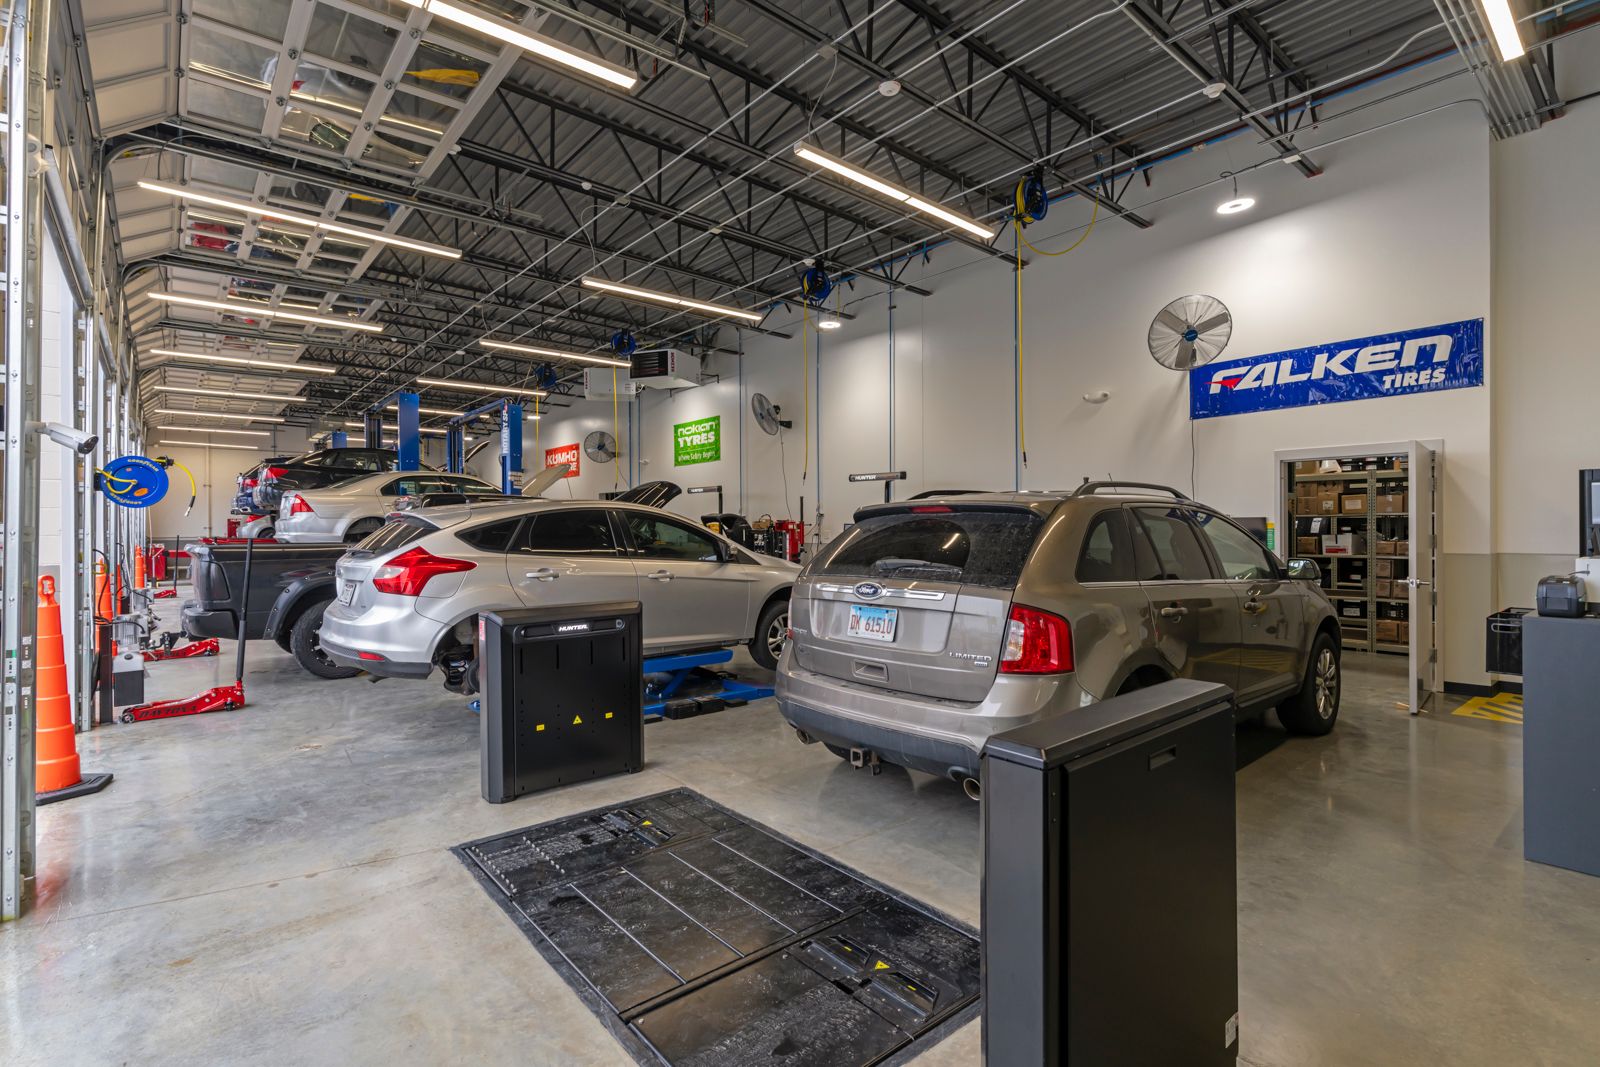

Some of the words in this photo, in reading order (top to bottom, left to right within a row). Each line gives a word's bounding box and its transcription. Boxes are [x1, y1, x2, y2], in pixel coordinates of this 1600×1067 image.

[1204, 334, 1453, 395] FALKEN
[1382, 368, 1446, 390] TIRES
[677, 431, 716, 448] TYRES
[547, 449, 577, 466] KUMHO
[558, 623, 588, 632] HUNTER
[864, 615, 893, 634] 61510
[949, 651, 992, 662] LIMITED
